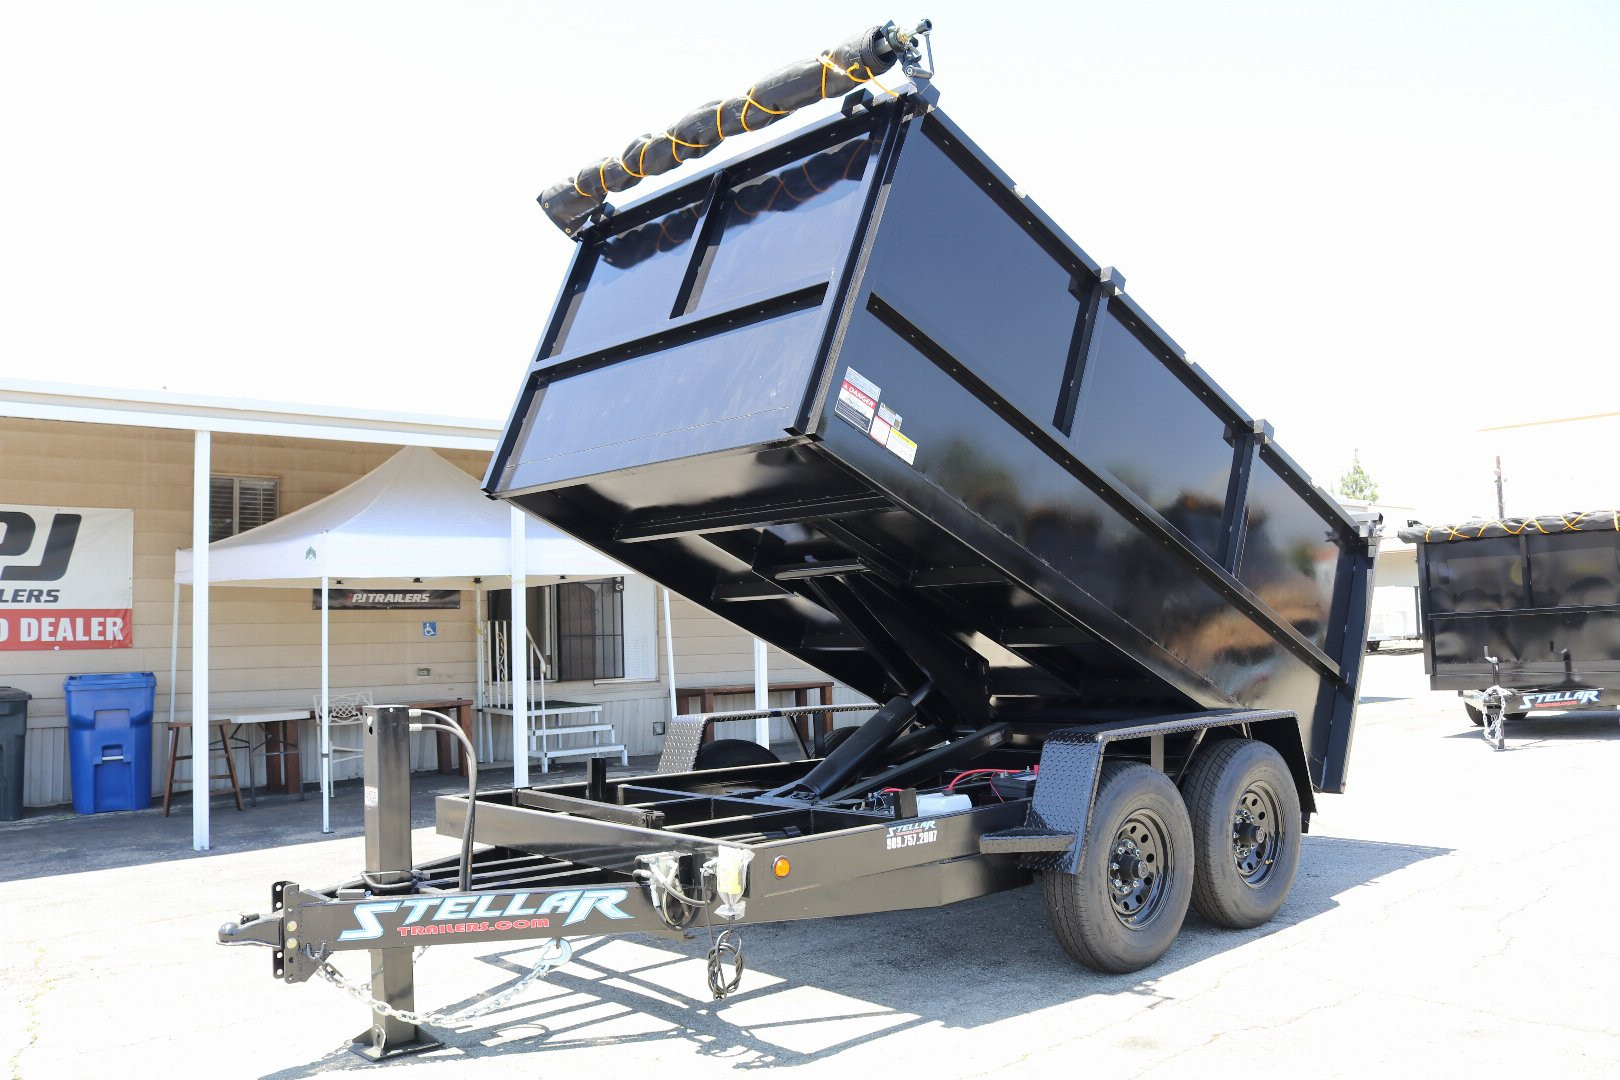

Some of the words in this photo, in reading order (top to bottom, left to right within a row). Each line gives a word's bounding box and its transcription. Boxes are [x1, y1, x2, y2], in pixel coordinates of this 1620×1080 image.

[848, 385, 874, 408] DANGER
[20, 617, 124, 642] DEALER
[1519, 690, 1601, 710] STELLAR
[886, 820, 937, 838] STELLAR
[337, 887, 635, 942] STELLAR
[396, 918, 550, 937] TRAILERS.COM
